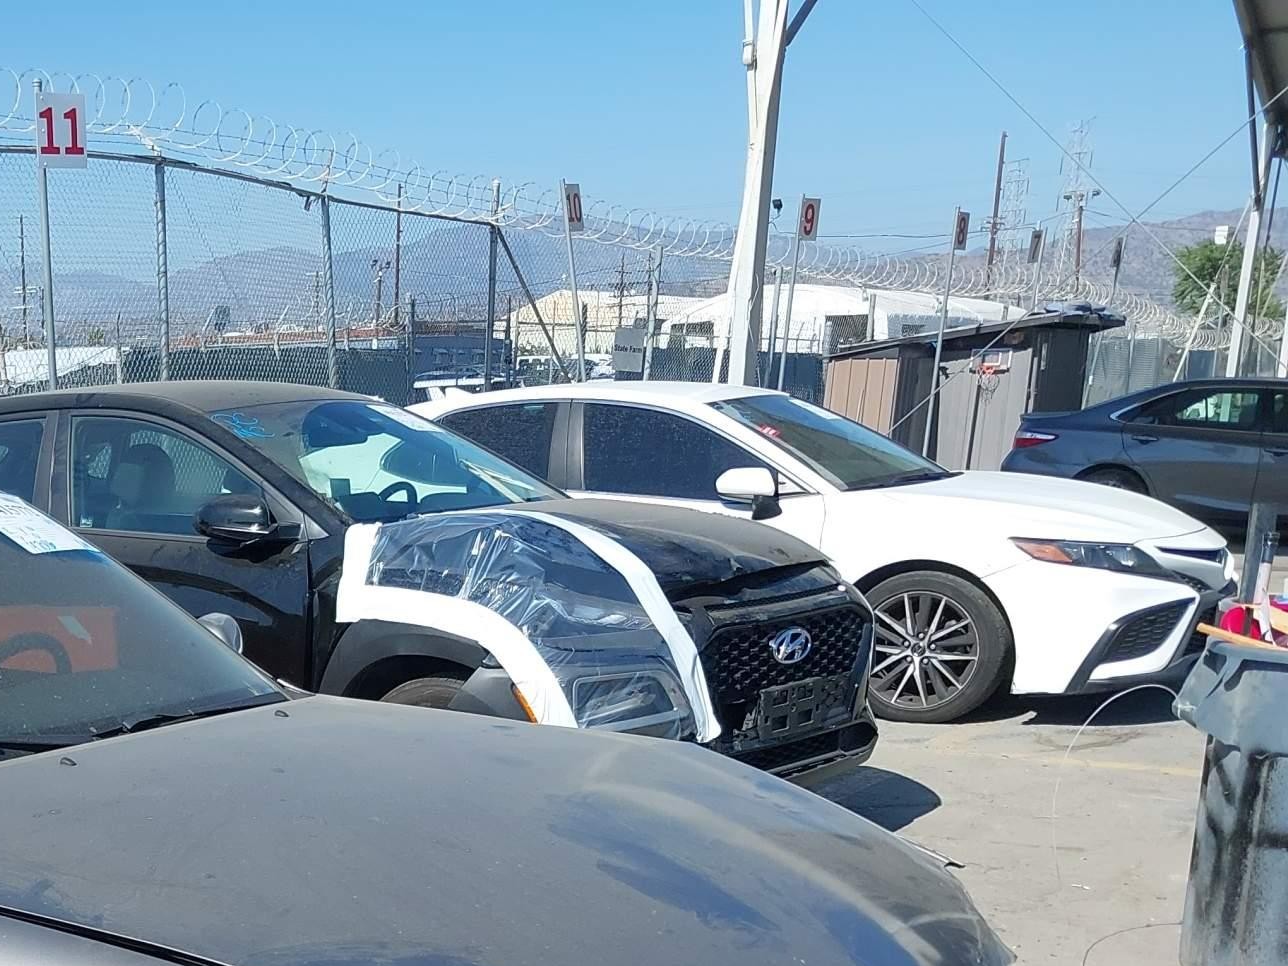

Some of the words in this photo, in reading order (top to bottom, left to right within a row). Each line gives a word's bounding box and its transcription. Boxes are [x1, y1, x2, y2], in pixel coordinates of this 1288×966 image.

[39, 106, 85, 155] 11
[566, 192, 582, 223] 10
[803, 203, 815, 236] 9
[957, 216, 966, 246] 8
[1032, 233, 1042, 259] 7
[614, 343, 628, 352] State
